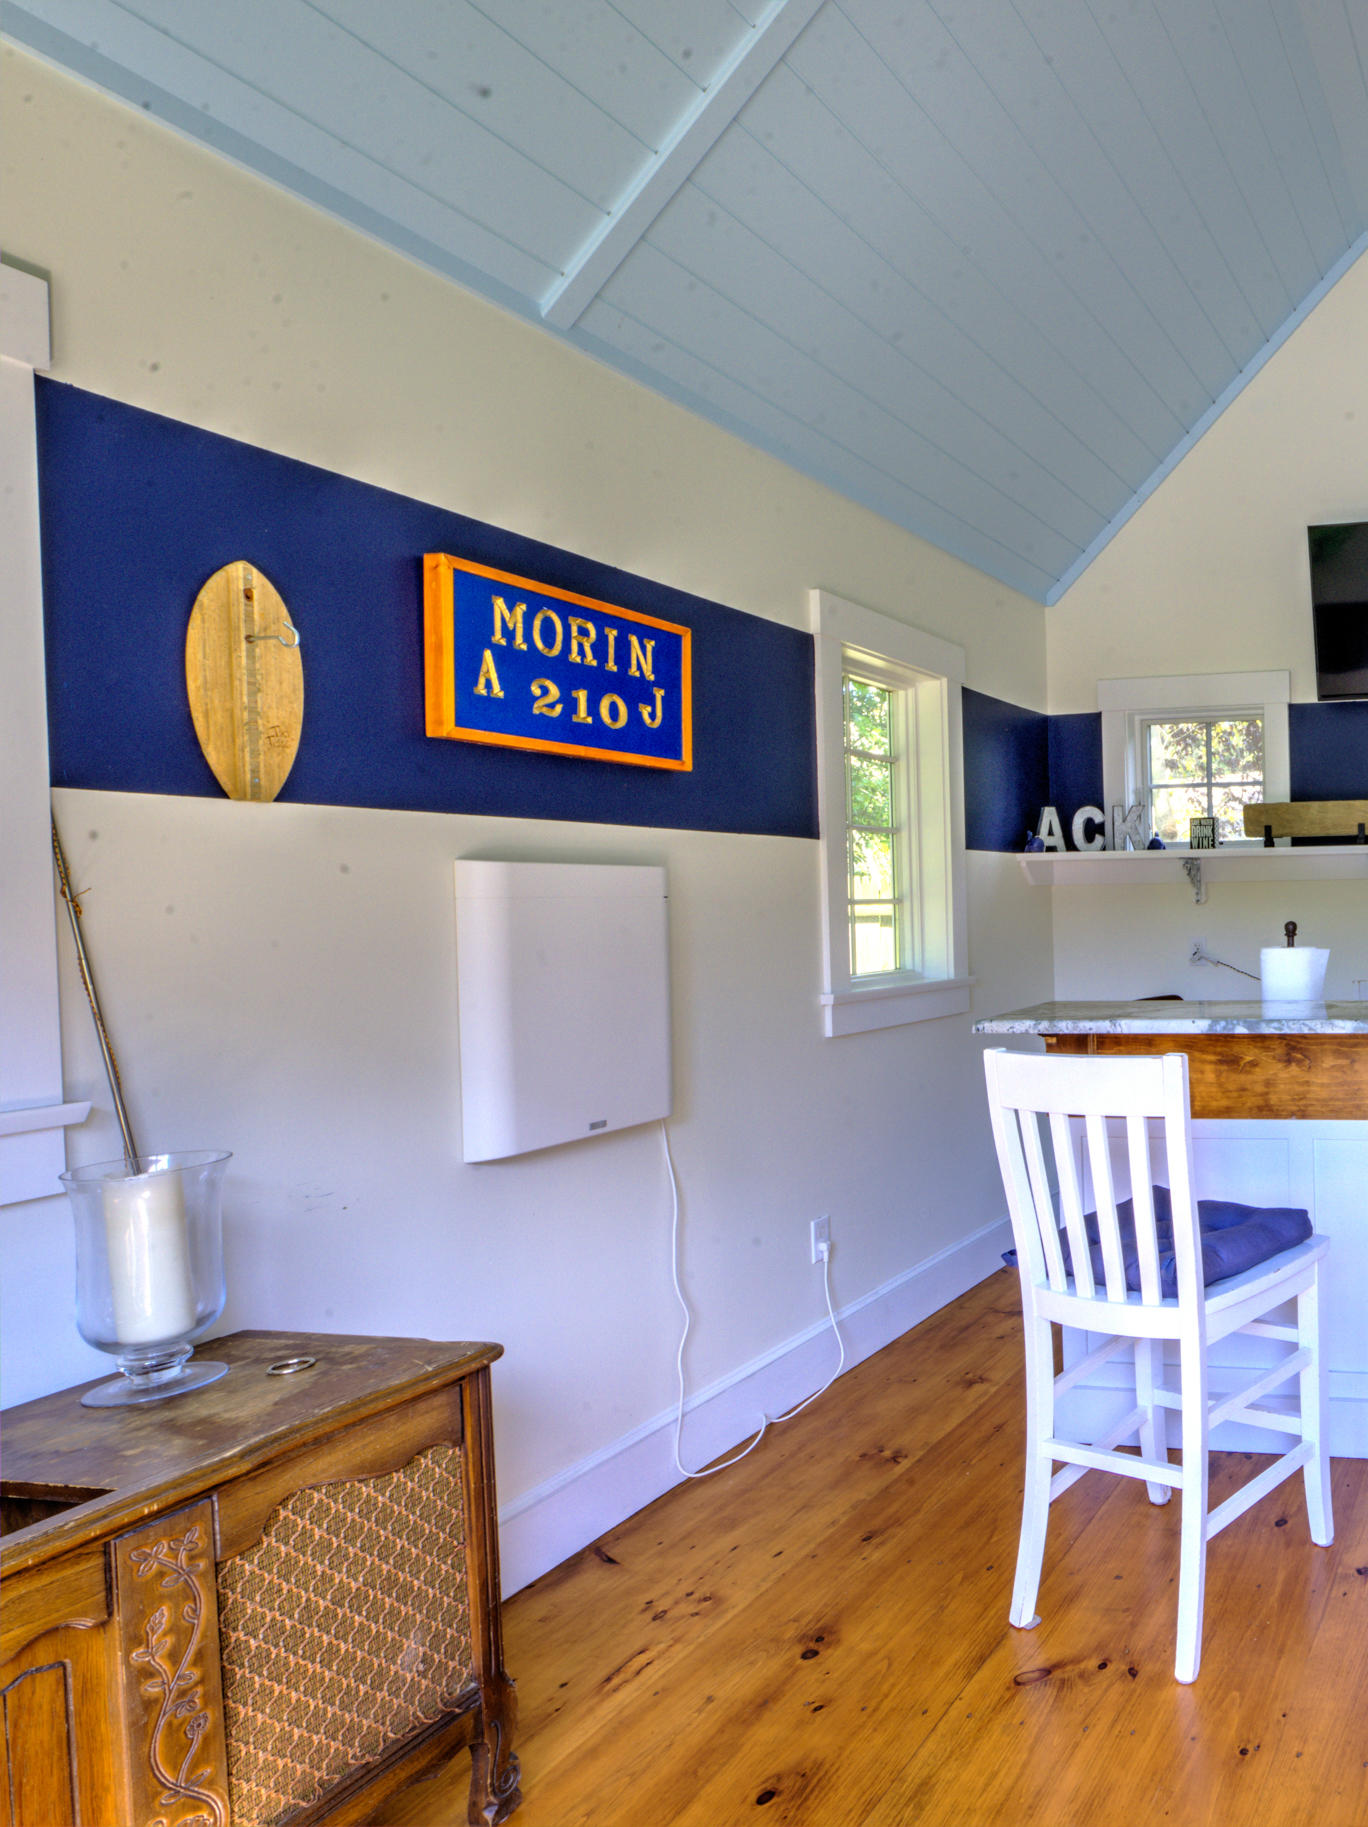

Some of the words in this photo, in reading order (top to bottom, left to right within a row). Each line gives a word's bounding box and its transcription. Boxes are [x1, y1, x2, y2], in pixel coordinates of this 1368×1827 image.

[491, 595, 656, 682] MORIN
[473, 648, 505, 699] A
[1036, 804, 1148, 852] ACK
[1191, 825, 1213, 838] DRINK
[1191, 837, 1214, 849] WINE
